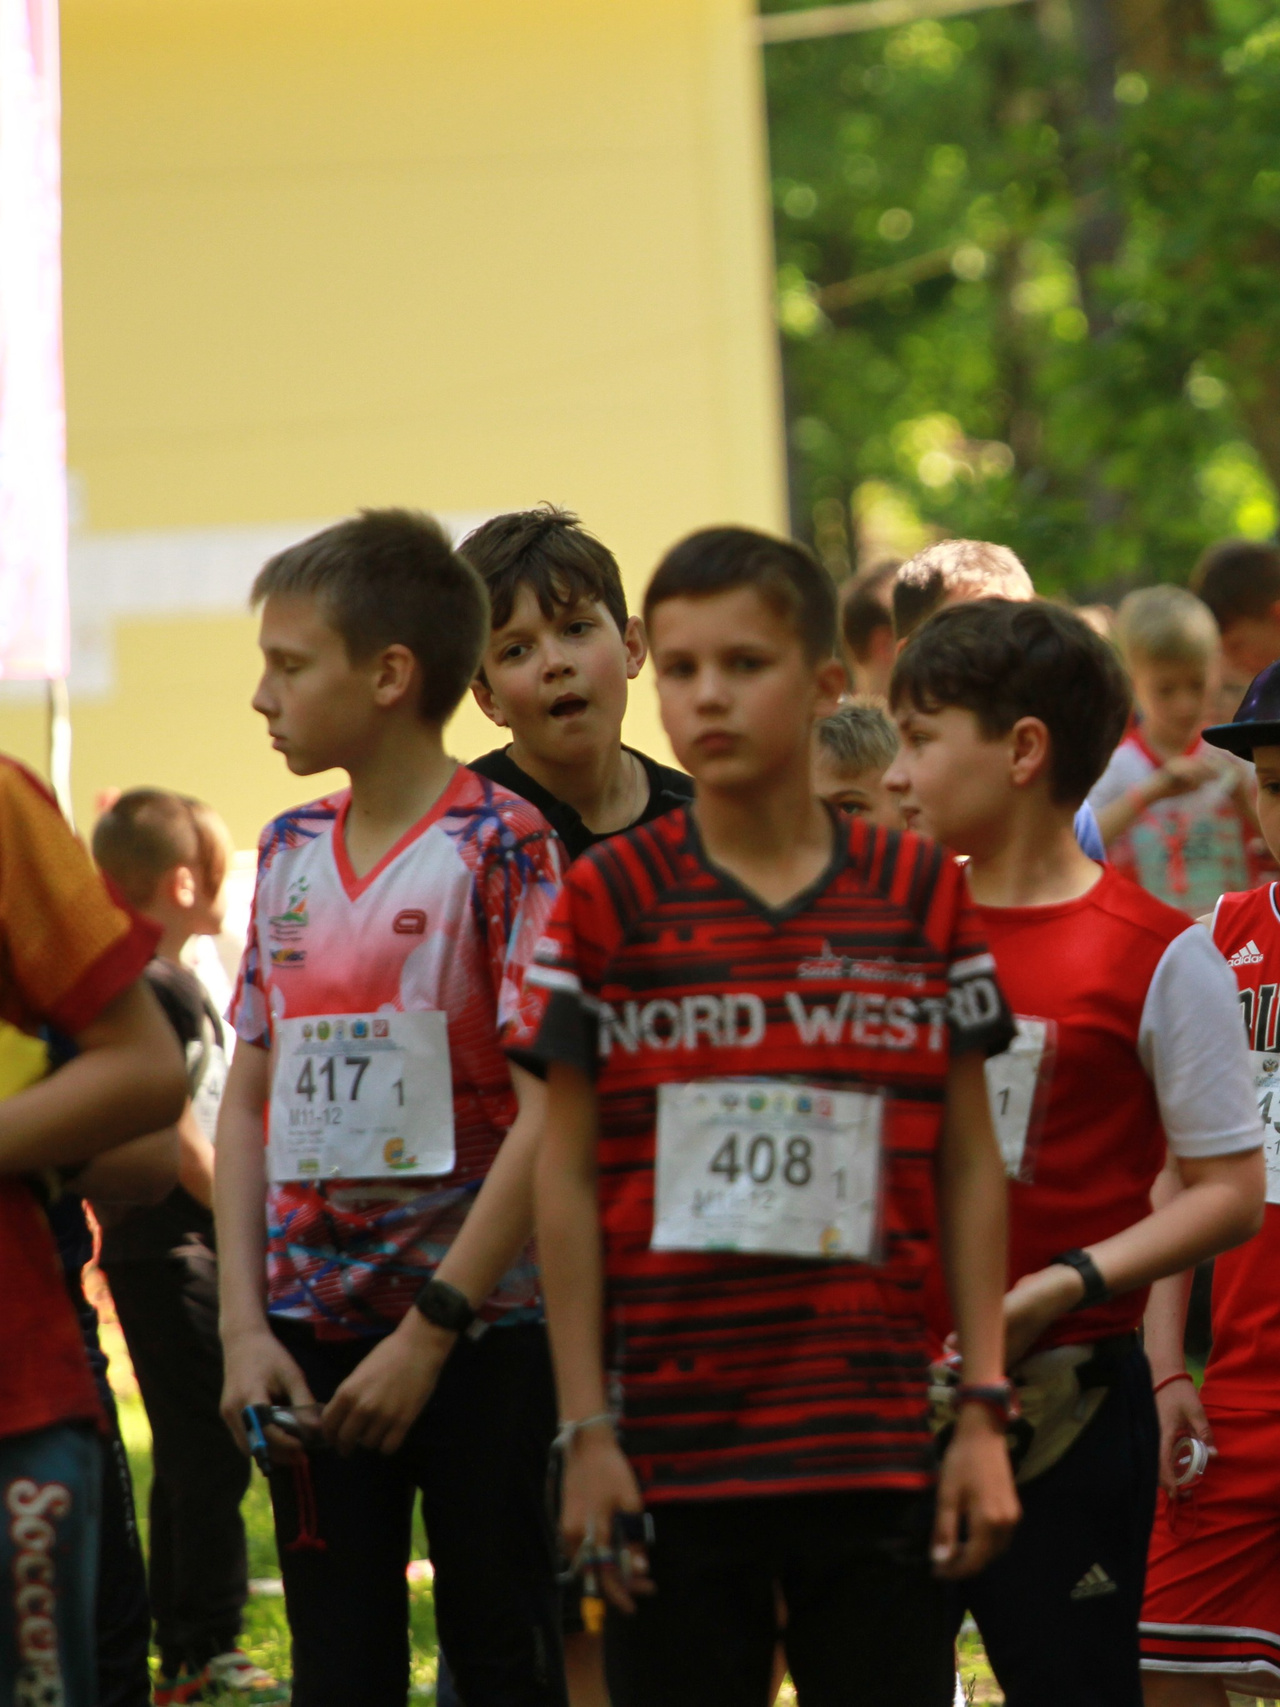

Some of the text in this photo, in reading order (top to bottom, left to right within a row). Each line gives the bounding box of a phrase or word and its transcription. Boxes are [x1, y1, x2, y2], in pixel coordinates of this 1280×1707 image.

[1227, 953, 1264, 967] adidas
[599, 990, 947, 1056] NORD WEST
[295, 1055, 371, 1102] 417
[392, 1078, 404, 1106] 1
[710, 1132, 813, 1187] 408
[832, 1166, 848, 1200] 1
